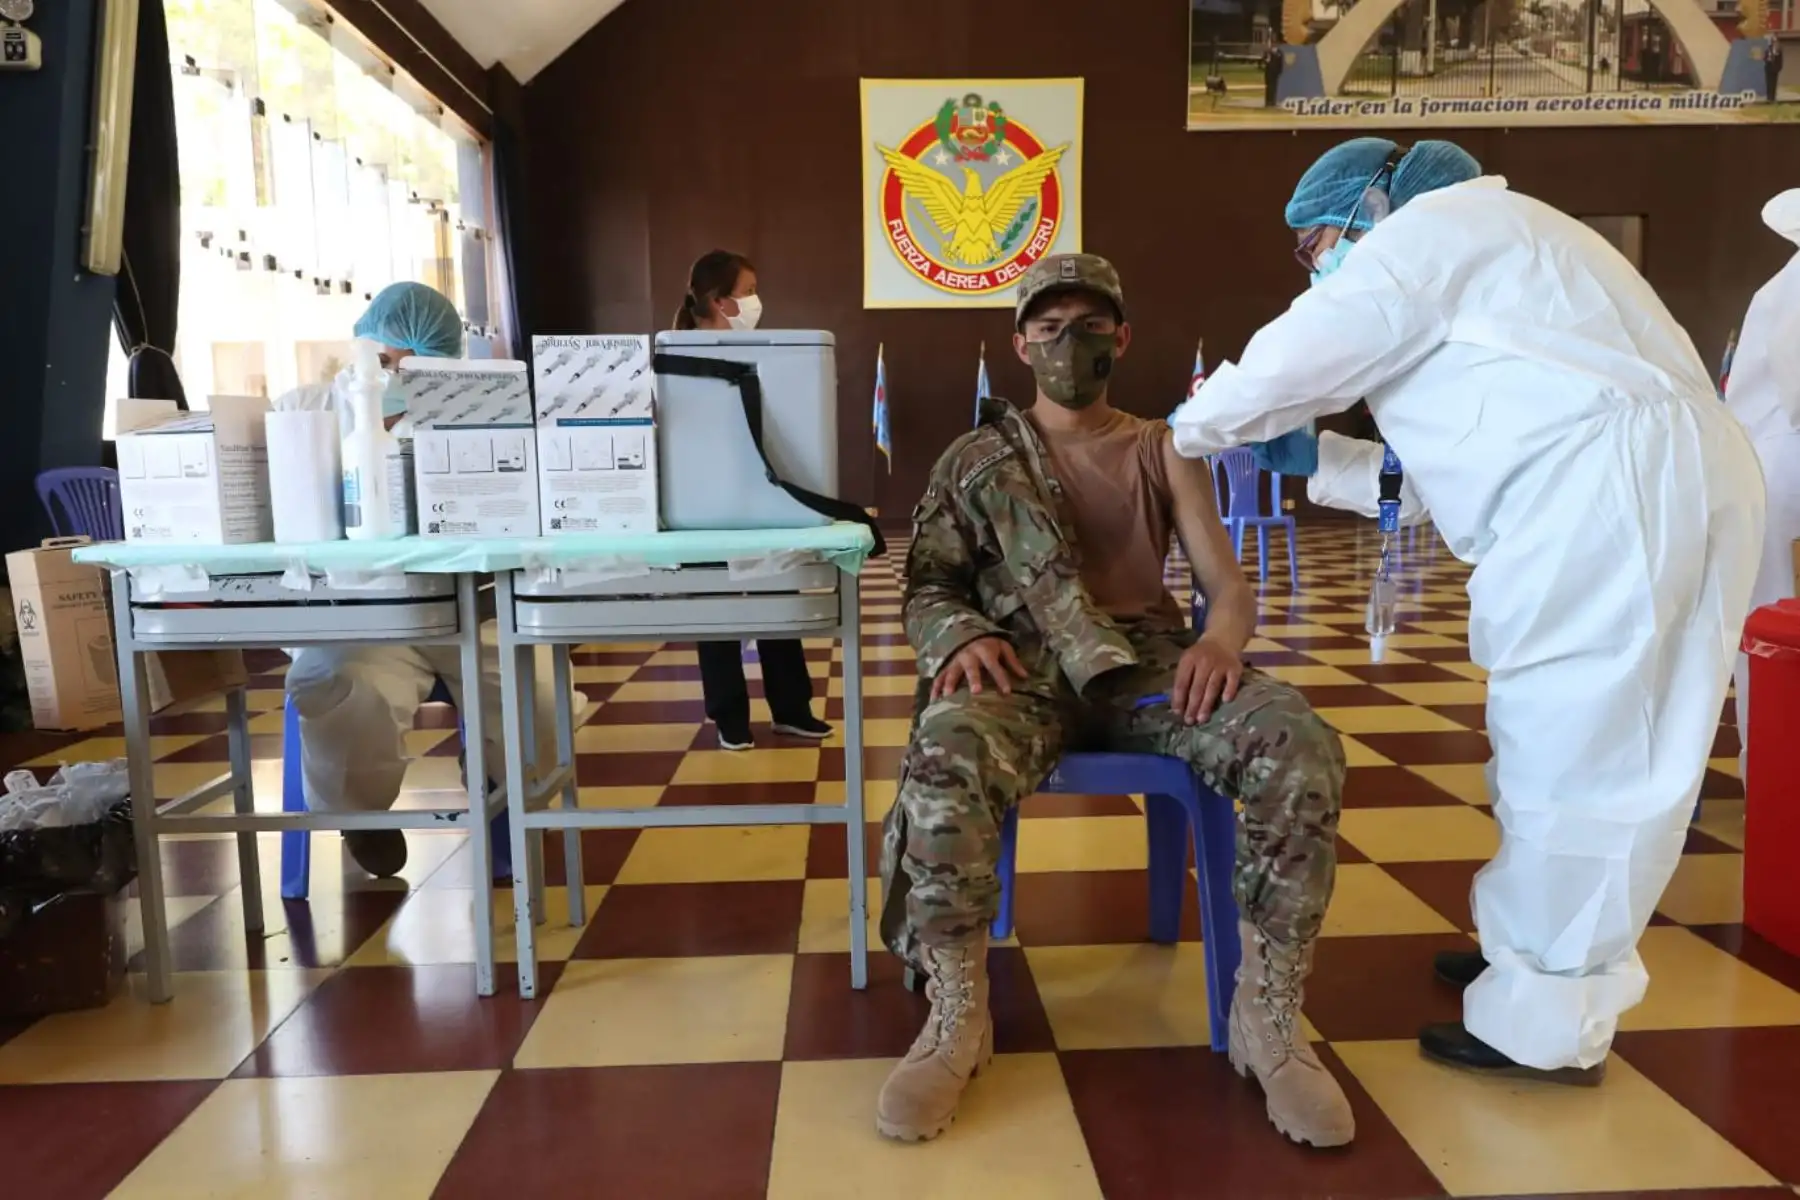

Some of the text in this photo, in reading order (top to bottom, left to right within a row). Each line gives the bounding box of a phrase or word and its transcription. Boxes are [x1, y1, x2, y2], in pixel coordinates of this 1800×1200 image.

[1360, 101, 1386, 115] en
[1393, 97, 1412, 114] la
[889, 218, 1055, 289] FUERZA AEREA DEL PERU
